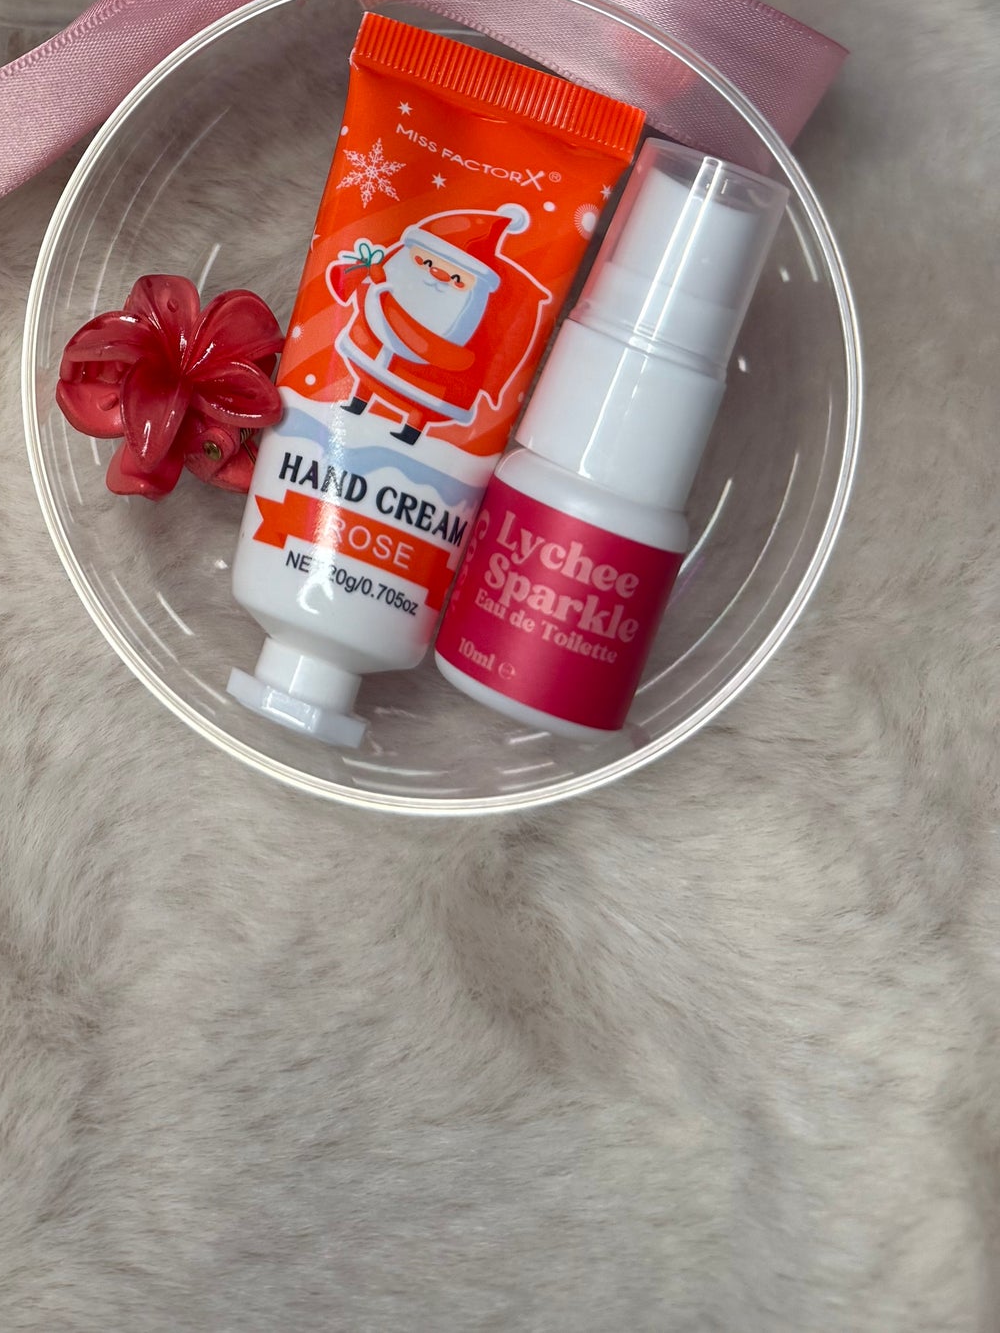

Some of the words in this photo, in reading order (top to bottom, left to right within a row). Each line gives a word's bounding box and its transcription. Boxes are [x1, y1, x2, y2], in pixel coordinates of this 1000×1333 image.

[396, 123, 437, 152] MISS
[278, 452, 368, 503] HAND
[376, 486, 468, 547] CREAM
[285, 550, 324, 577] NE
[323, 515, 415, 569] ROSE
[496, 510, 640, 598] Lychee
[474, 588, 507, 620] Eau
[509, 609, 536, 633] de
[541, 620, 618, 664] Toilette
[484, 553, 640, 643] Sparkle
[458, 637, 496, 671] 10ml
